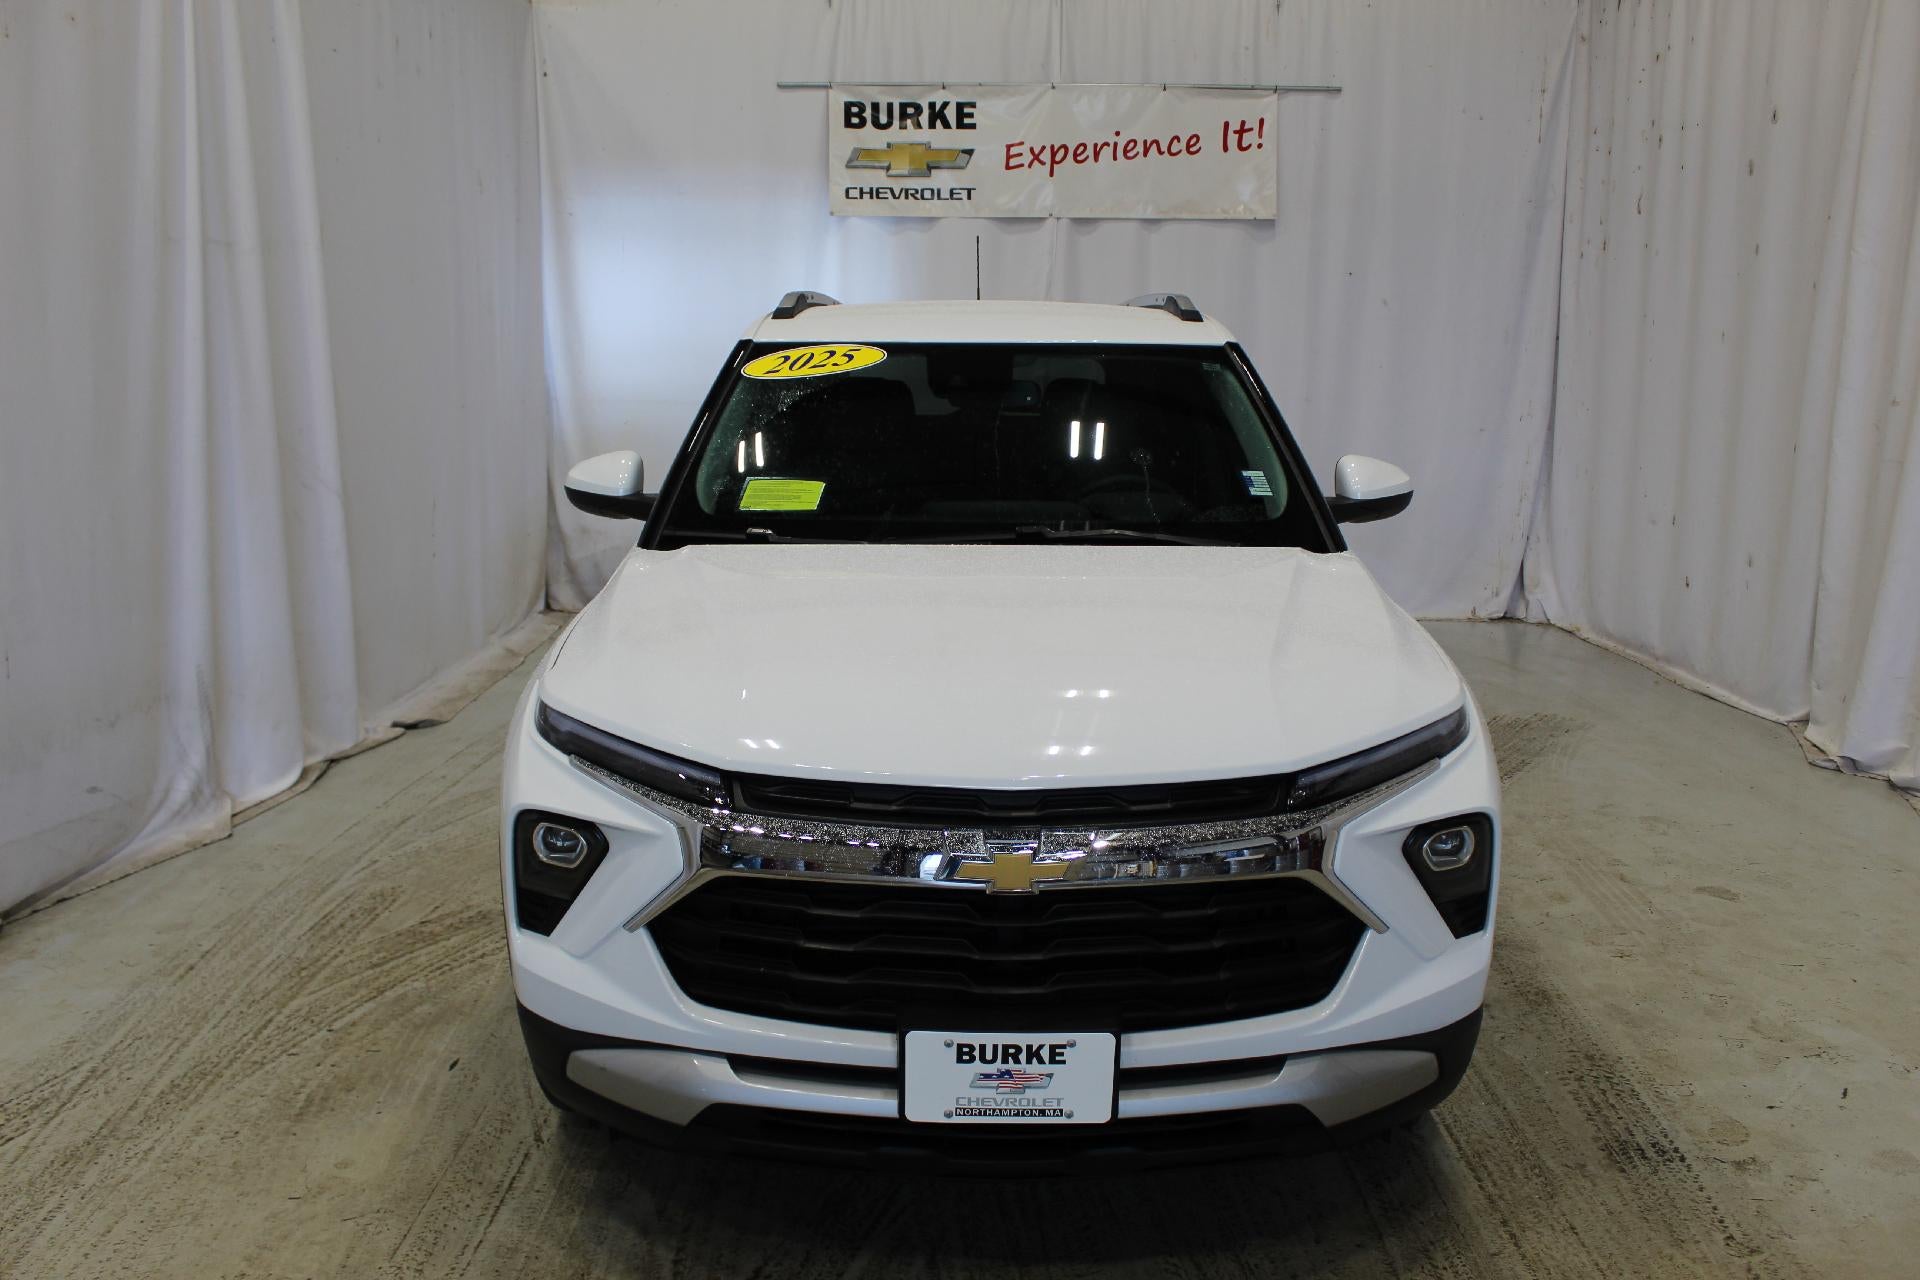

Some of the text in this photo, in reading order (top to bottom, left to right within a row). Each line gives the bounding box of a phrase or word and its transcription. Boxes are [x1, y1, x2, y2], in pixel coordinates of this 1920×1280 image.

[843, 100, 977, 130] BURKE
[1004, 118, 1266, 178] Experience It!
[845, 187, 977, 201] CHEVROLET
[763, 349, 862, 375] 2025
[955, 1043, 1068, 1065] BURKE
[955, 1097, 1065, 1107] CHEVROLET
[1045, 1108, 1062, 1117] MA
